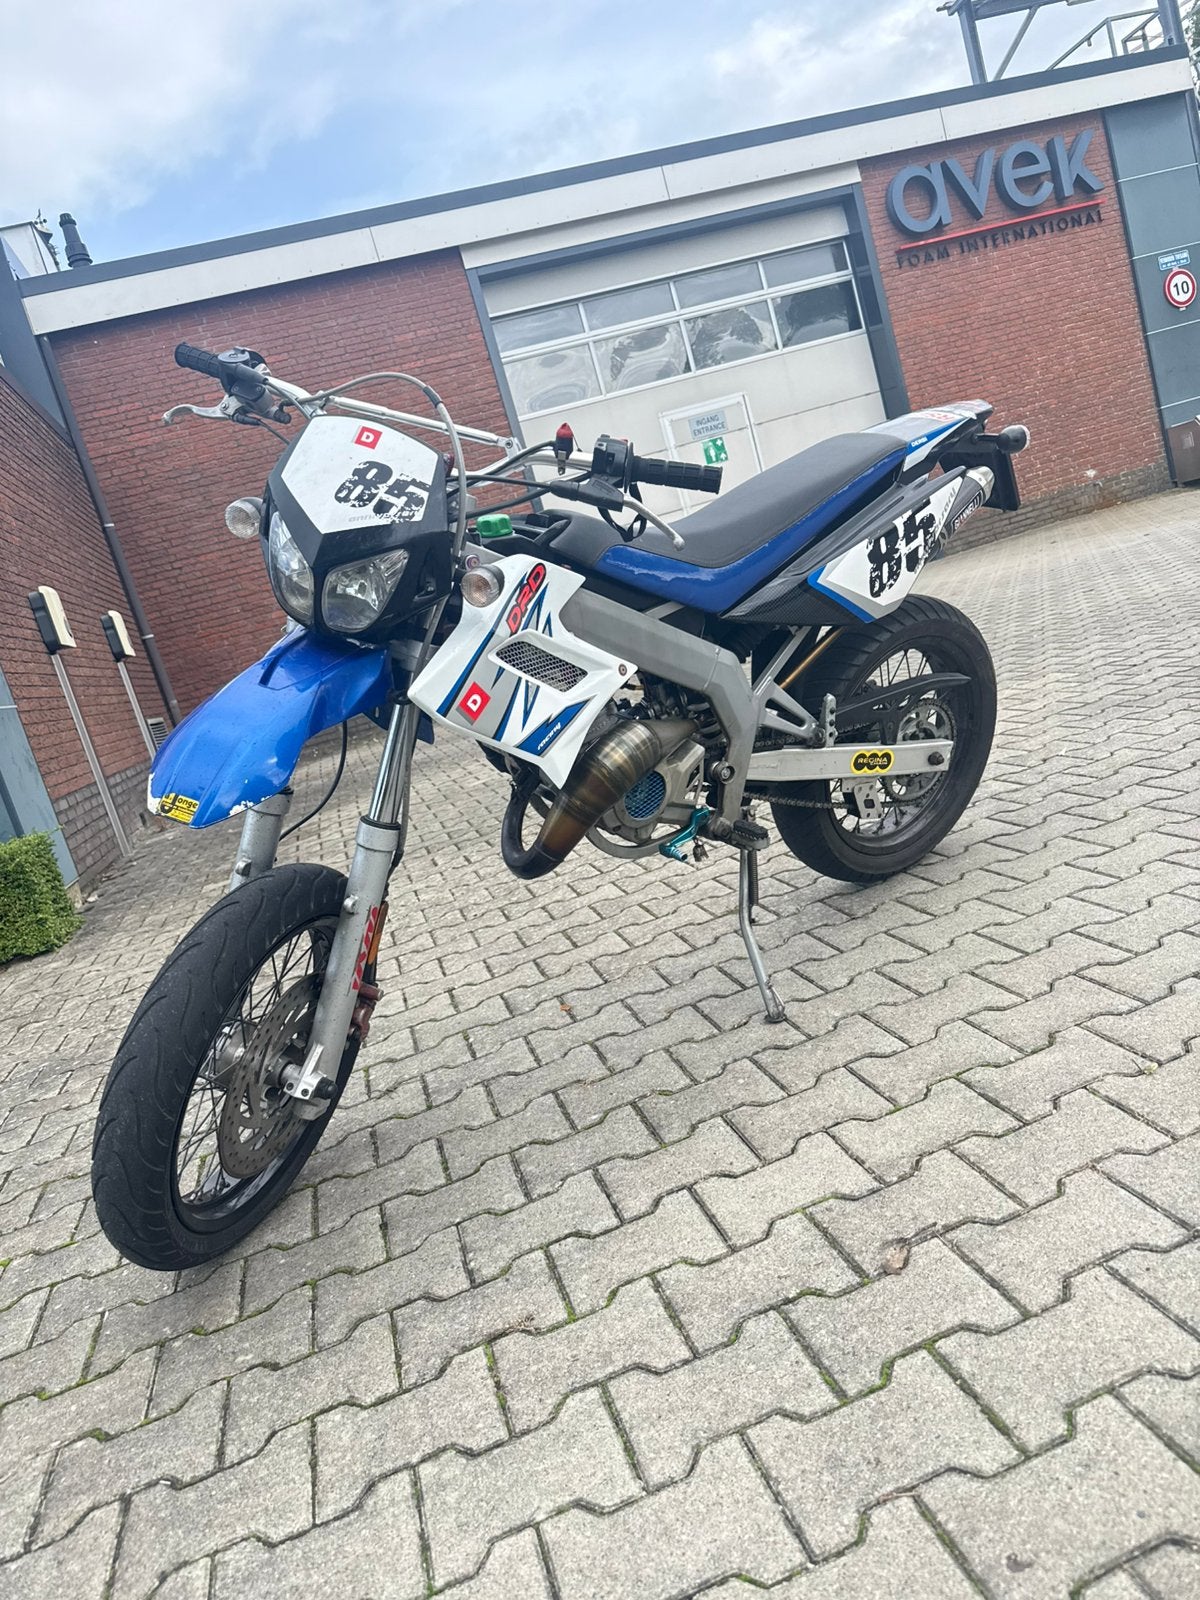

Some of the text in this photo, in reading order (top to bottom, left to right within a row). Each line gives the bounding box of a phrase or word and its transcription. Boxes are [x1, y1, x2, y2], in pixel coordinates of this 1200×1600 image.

[887, 129, 1104, 236] avek
[896, 210, 1104, 269] FOAM INTERNATIONAL
[1173, 281, 1190, 296] 10
[693, 421, 726, 437] ENTRANCE
[696, 414, 720, 427] INGANG
[334, 461, 431, 522] 85
[506, 563, 547, 636] DRD
